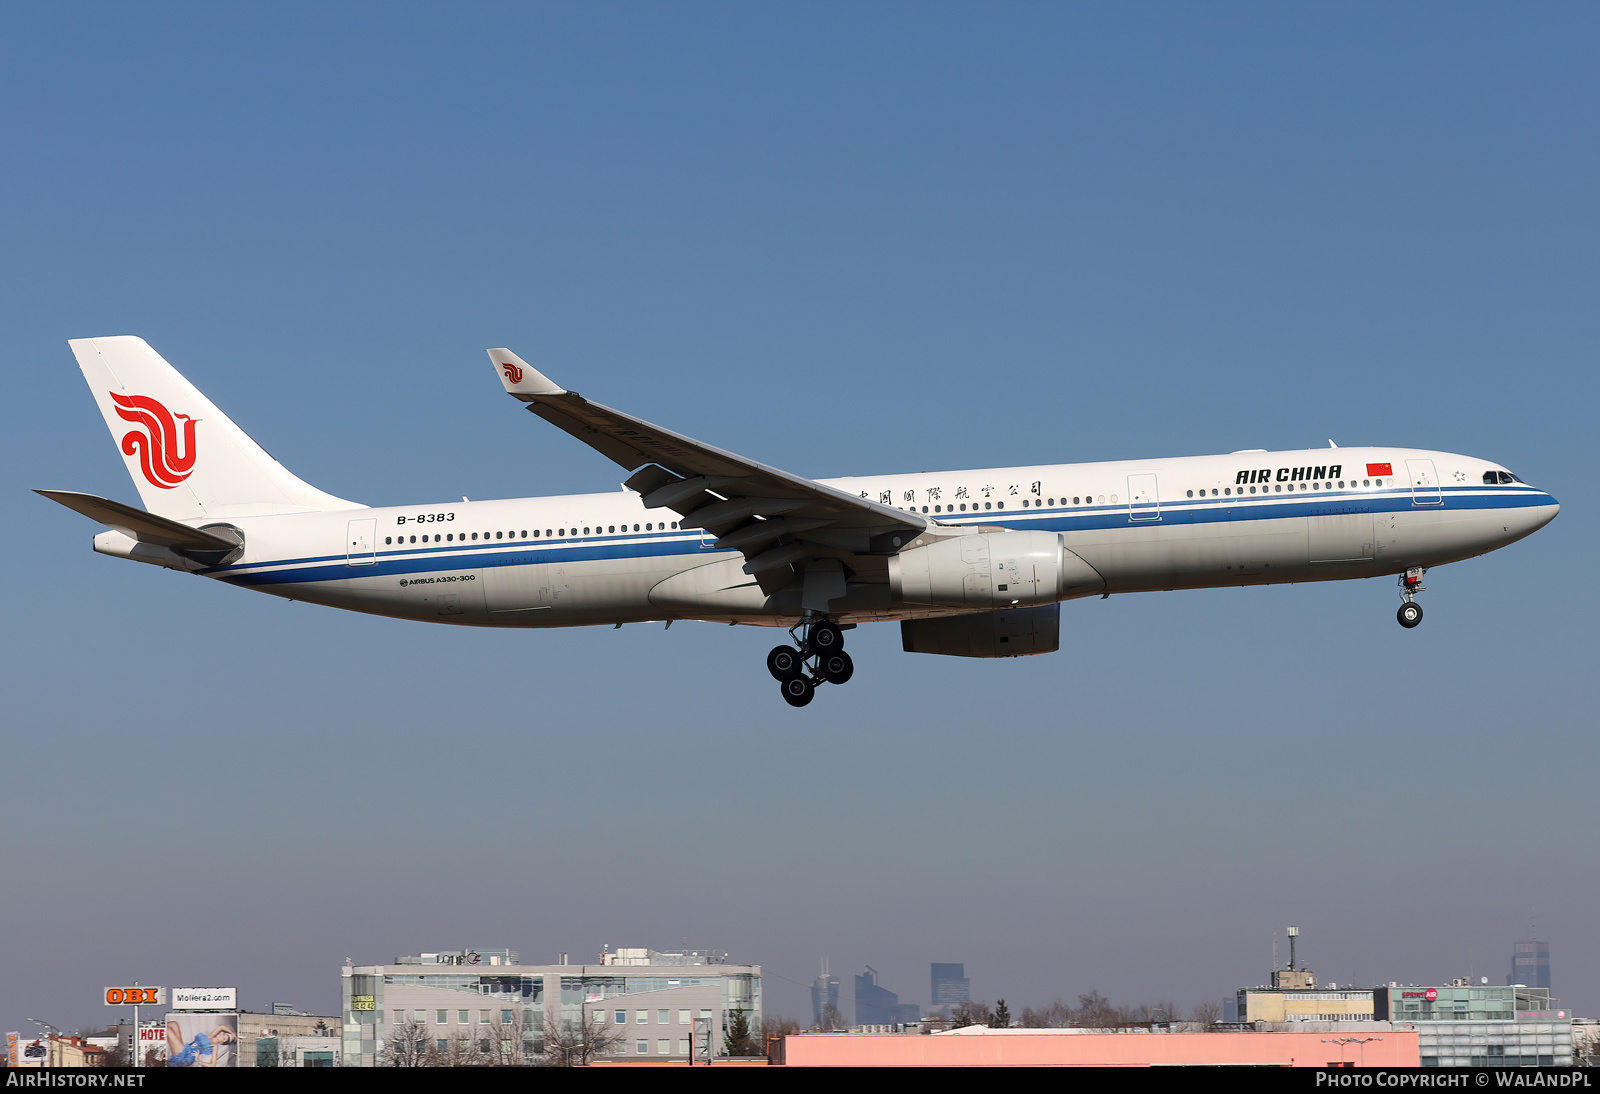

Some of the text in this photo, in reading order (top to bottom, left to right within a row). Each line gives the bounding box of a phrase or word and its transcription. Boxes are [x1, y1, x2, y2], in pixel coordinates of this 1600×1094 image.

[1236, 465, 1342, 484] AIR CHINA
[397, 513, 455, 525] B-8383
[436, 575, 476, 583] A330-300
[106, 989, 158, 1004] OBI
[177, 994, 230, 1002] Moliera2.com
[140, 1029, 165, 1040] HOTE
